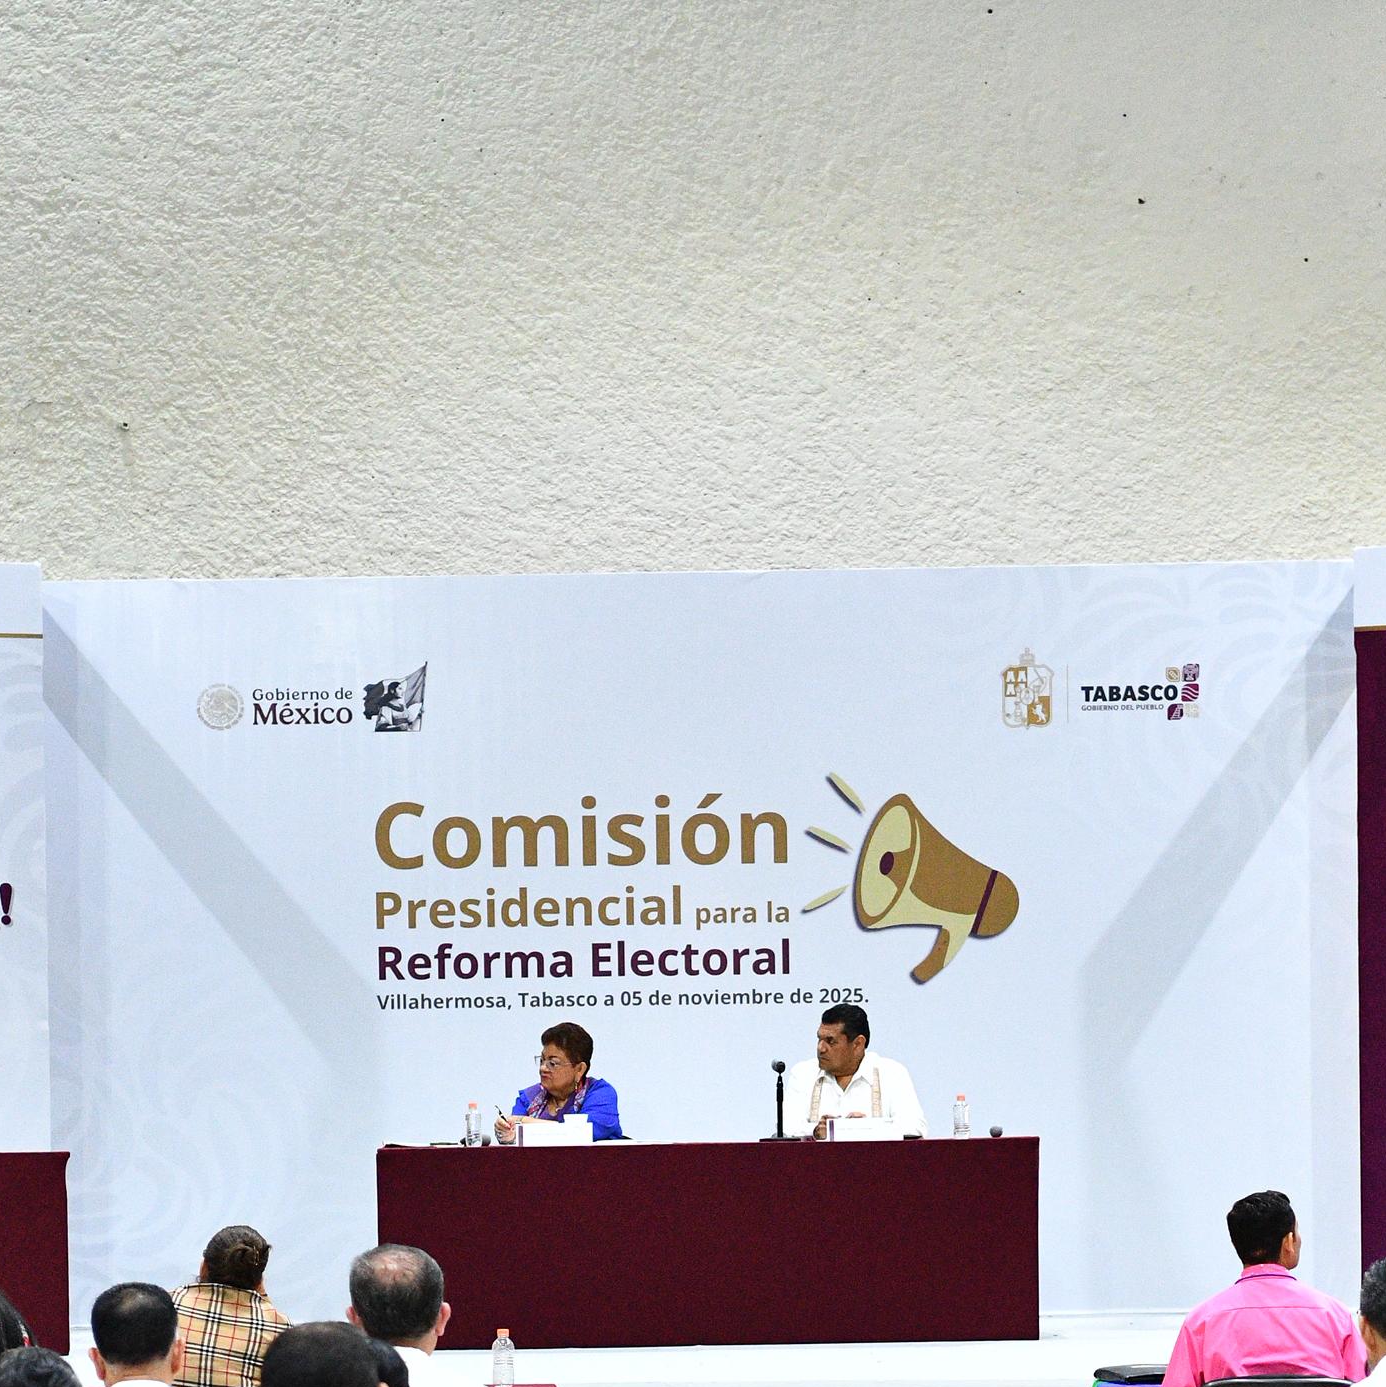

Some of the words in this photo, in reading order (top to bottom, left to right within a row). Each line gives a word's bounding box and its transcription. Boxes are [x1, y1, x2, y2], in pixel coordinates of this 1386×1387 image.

[252, 687, 330, 702] Gobierno
[334, 686, 353, 700] de
[1080, 684, 1179, 703] TABASCO
[252, 702, 353, 726] México
[1080, 704, 1119, 712] GOBIERNO
[1135, 703, 1165, 711] PUEBLO
[374, 792, 788, 871] Comisión
[375, 884, 682, 930] Presidencial
[695, 906, 757, 931] para
[767, 900, 790, 923] la
[378, 942, 573, 981] Reforma
[591, 937, 790, 978] Electoral
[376, 993, 512, 1011] Villahermosa,
[517, 991, 598, 1008] Tabasco
[603, 994, 614, 1007] a
[620, 990, 643, 1007] 05
[648, 989, 672, 1006] de
[678, 988, 783, 1006] noviembre
[789, 987, 813, 1004] de
[819, 987, 869, 1007] 2025.
